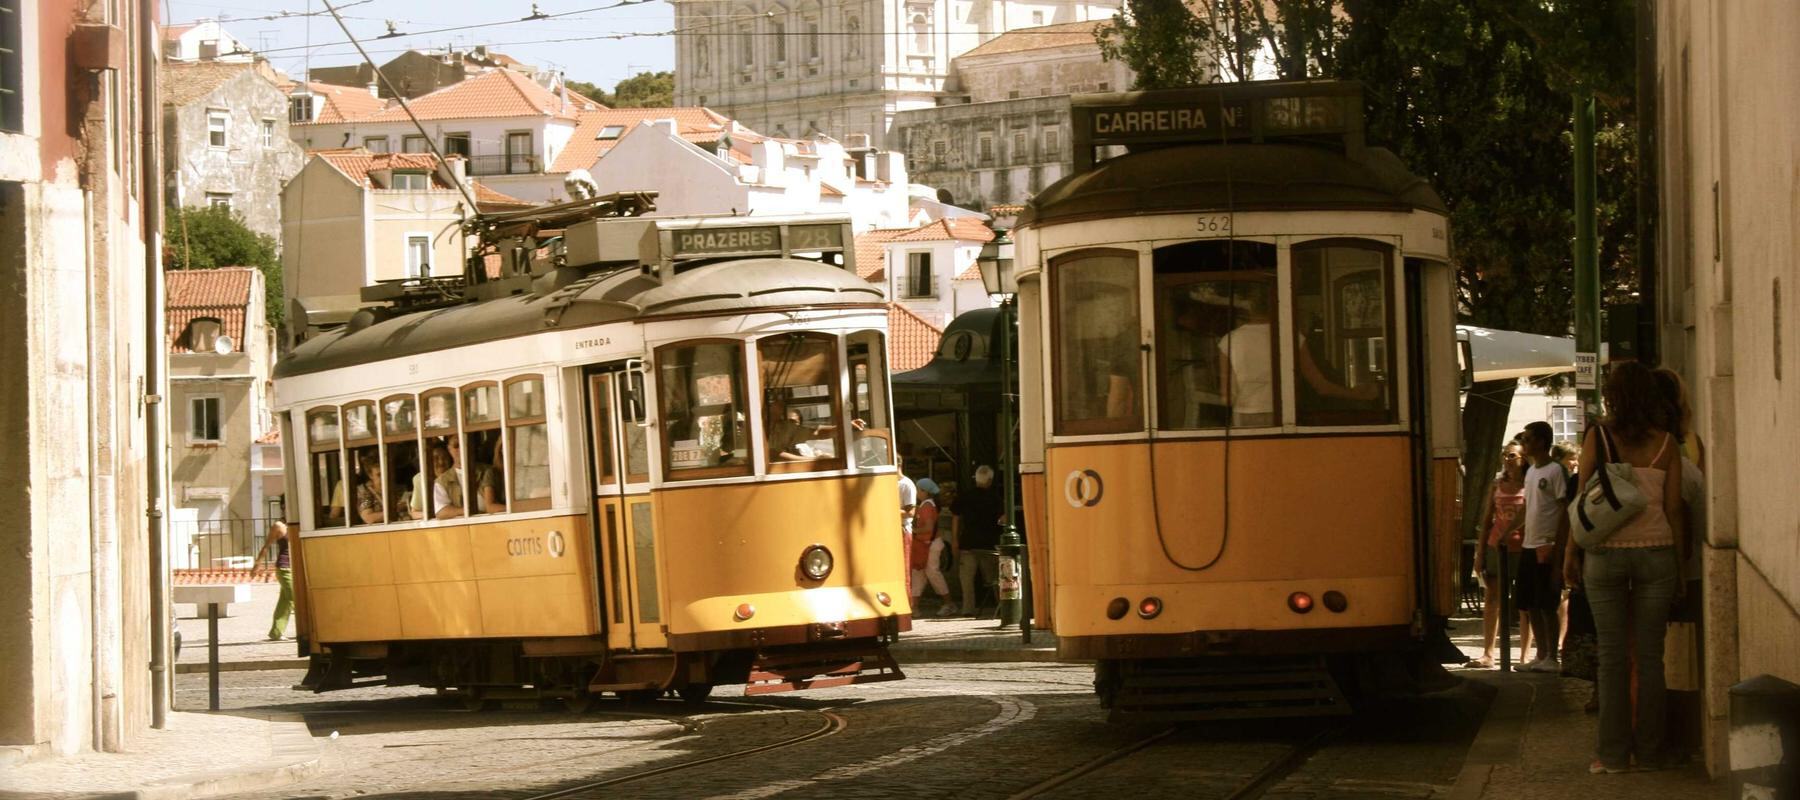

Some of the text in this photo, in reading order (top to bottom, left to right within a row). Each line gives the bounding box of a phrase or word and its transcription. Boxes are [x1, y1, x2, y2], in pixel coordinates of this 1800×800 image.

[1095, 109, 1207, 133] CARREIRA
[1197, 216, 1230, 231] 562
[681, 228, 832, 250] PRAZERES 28
[576, 337, 611, 350] ENTRADA
[506, 529, 543, 556] carris
